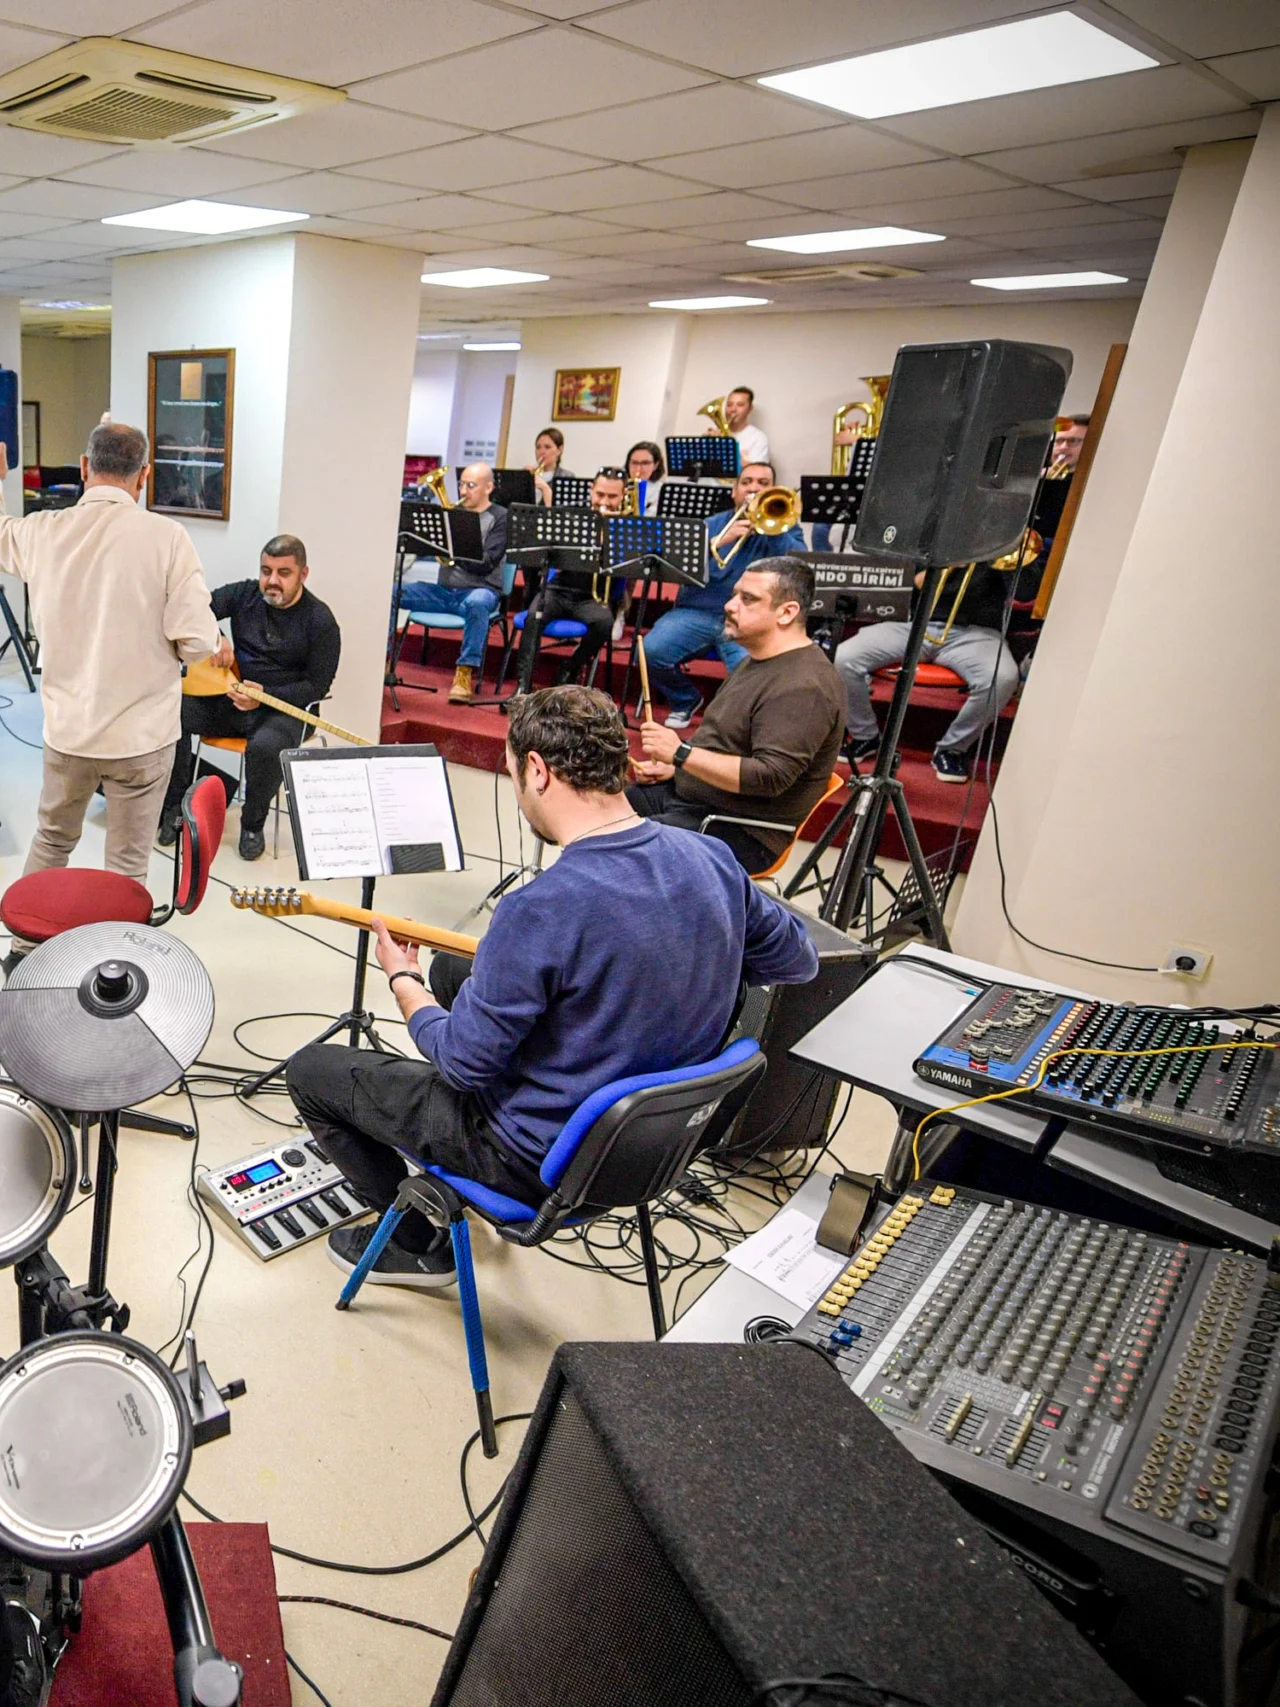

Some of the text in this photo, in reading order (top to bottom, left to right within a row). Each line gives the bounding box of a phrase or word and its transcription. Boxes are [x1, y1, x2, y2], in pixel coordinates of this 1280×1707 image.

[815, 571, 903, 587] NDO BİRİMİ
[930, 1068, 973, 1089] YAMAHA
[131, 1404, 148, 1436] Roland
